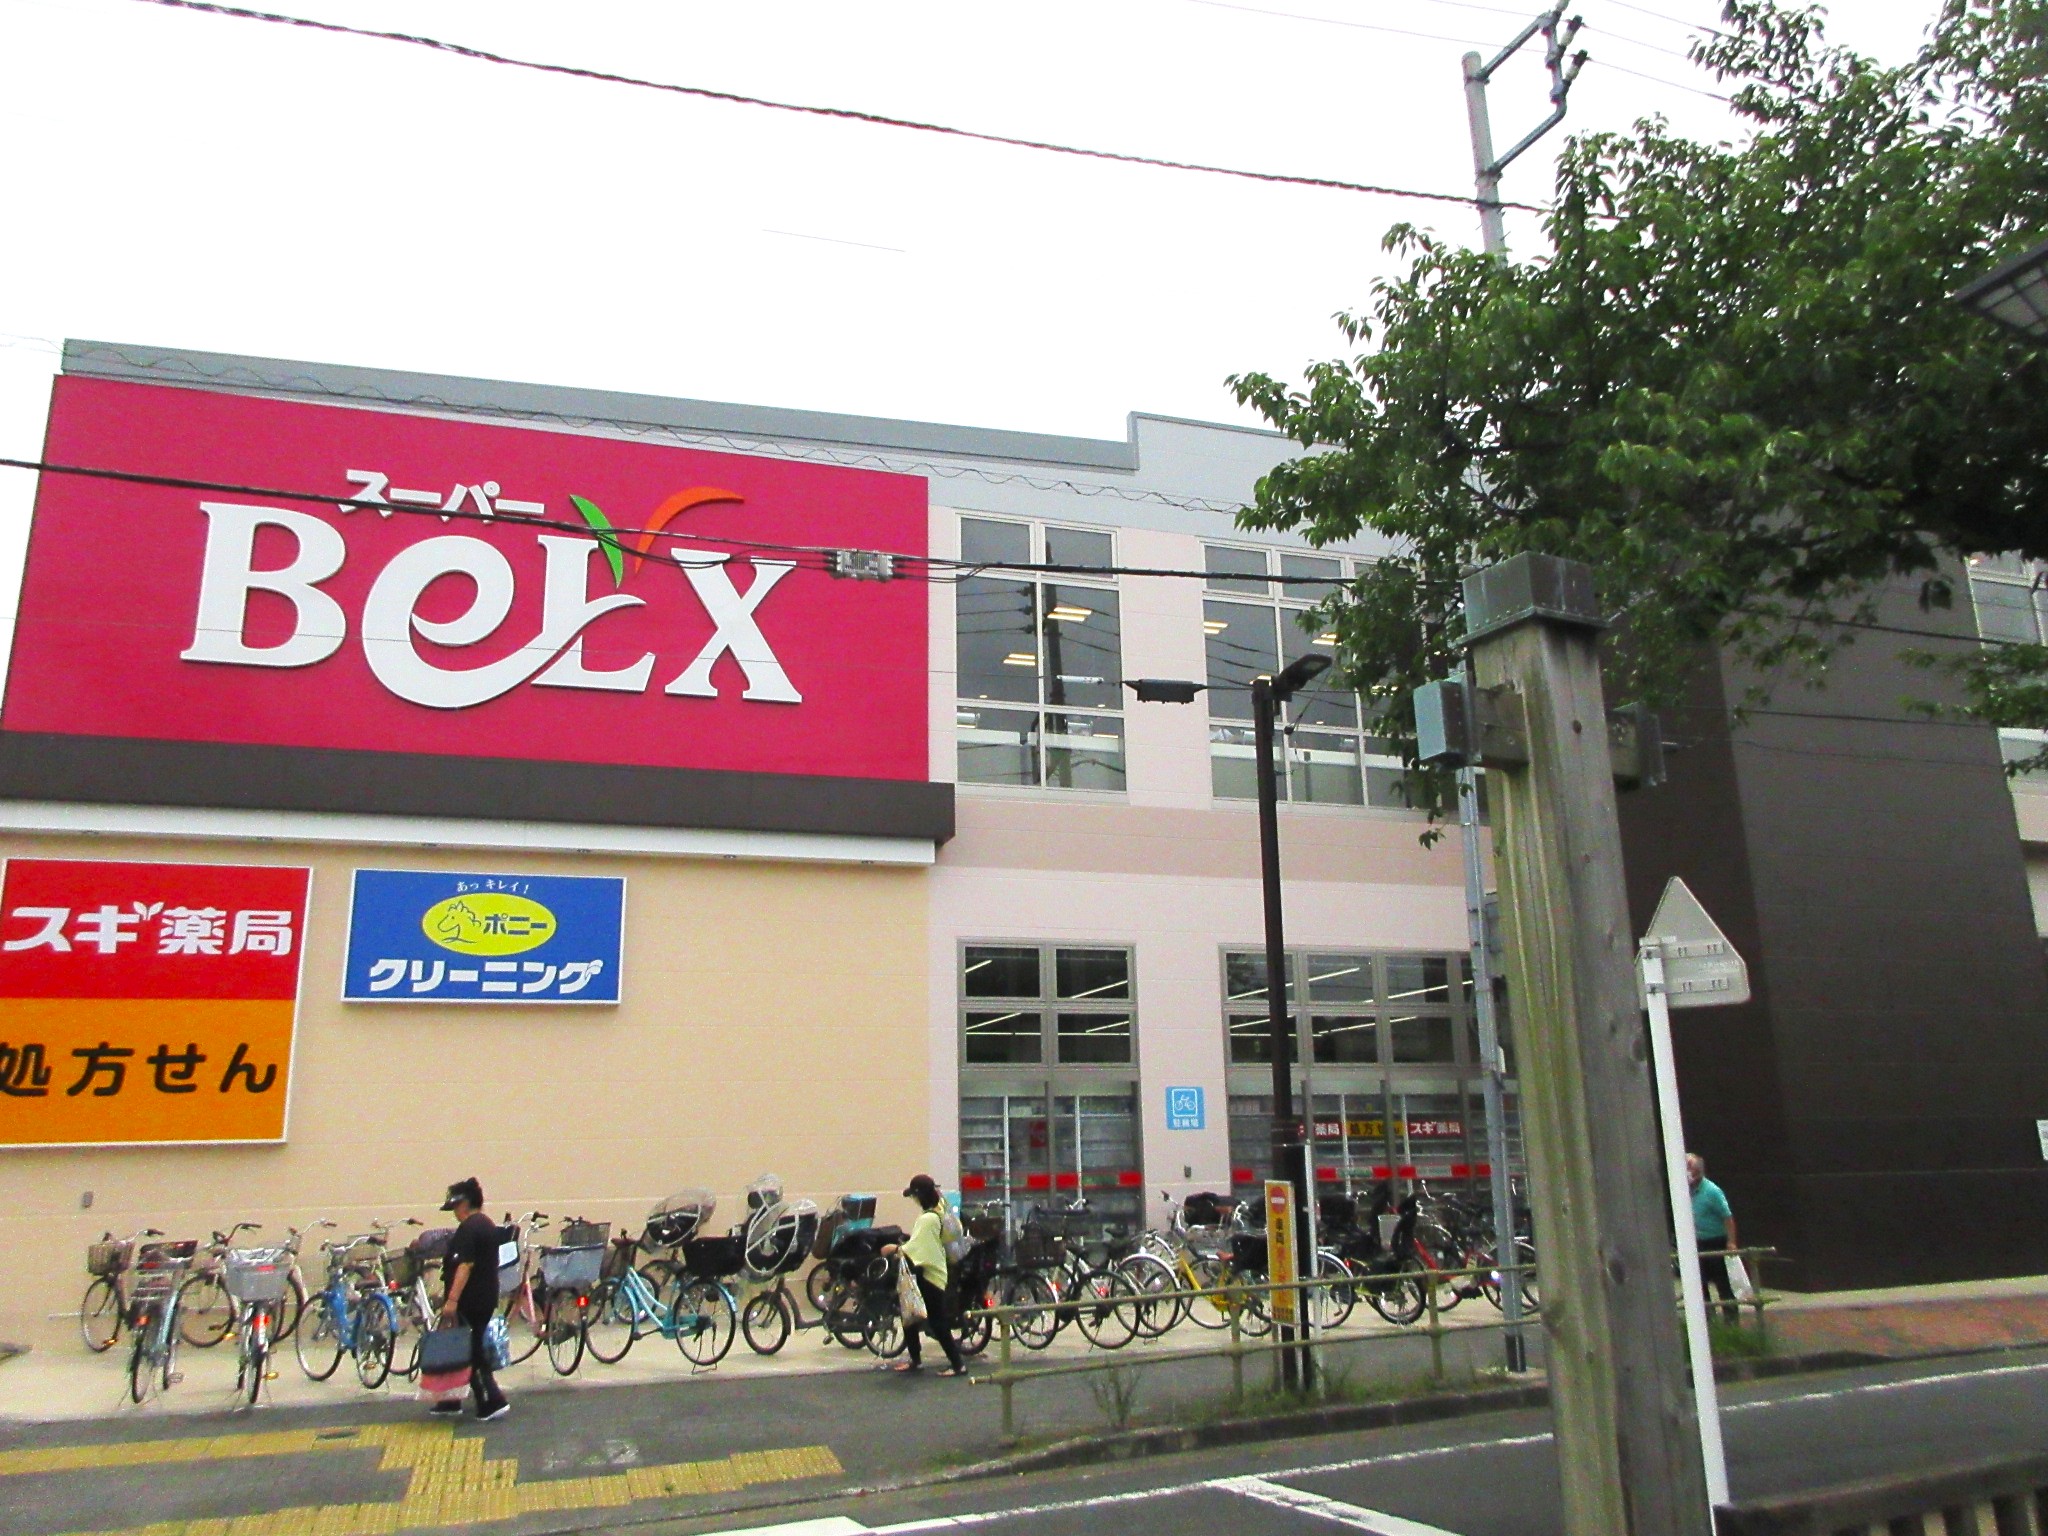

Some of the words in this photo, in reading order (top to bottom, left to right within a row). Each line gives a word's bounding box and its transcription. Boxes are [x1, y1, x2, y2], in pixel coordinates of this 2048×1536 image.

[336, 468, 546, 522] スーパー
[4, 901, 293, 956] スギ薬局
[483, 913, 548, 935] ポニー
[370, 958, 604, 994] クリーニング
[0, 1041, 278, 1097] 処方せん
[1410, 1121, 1461, 1134] スギ薬局
